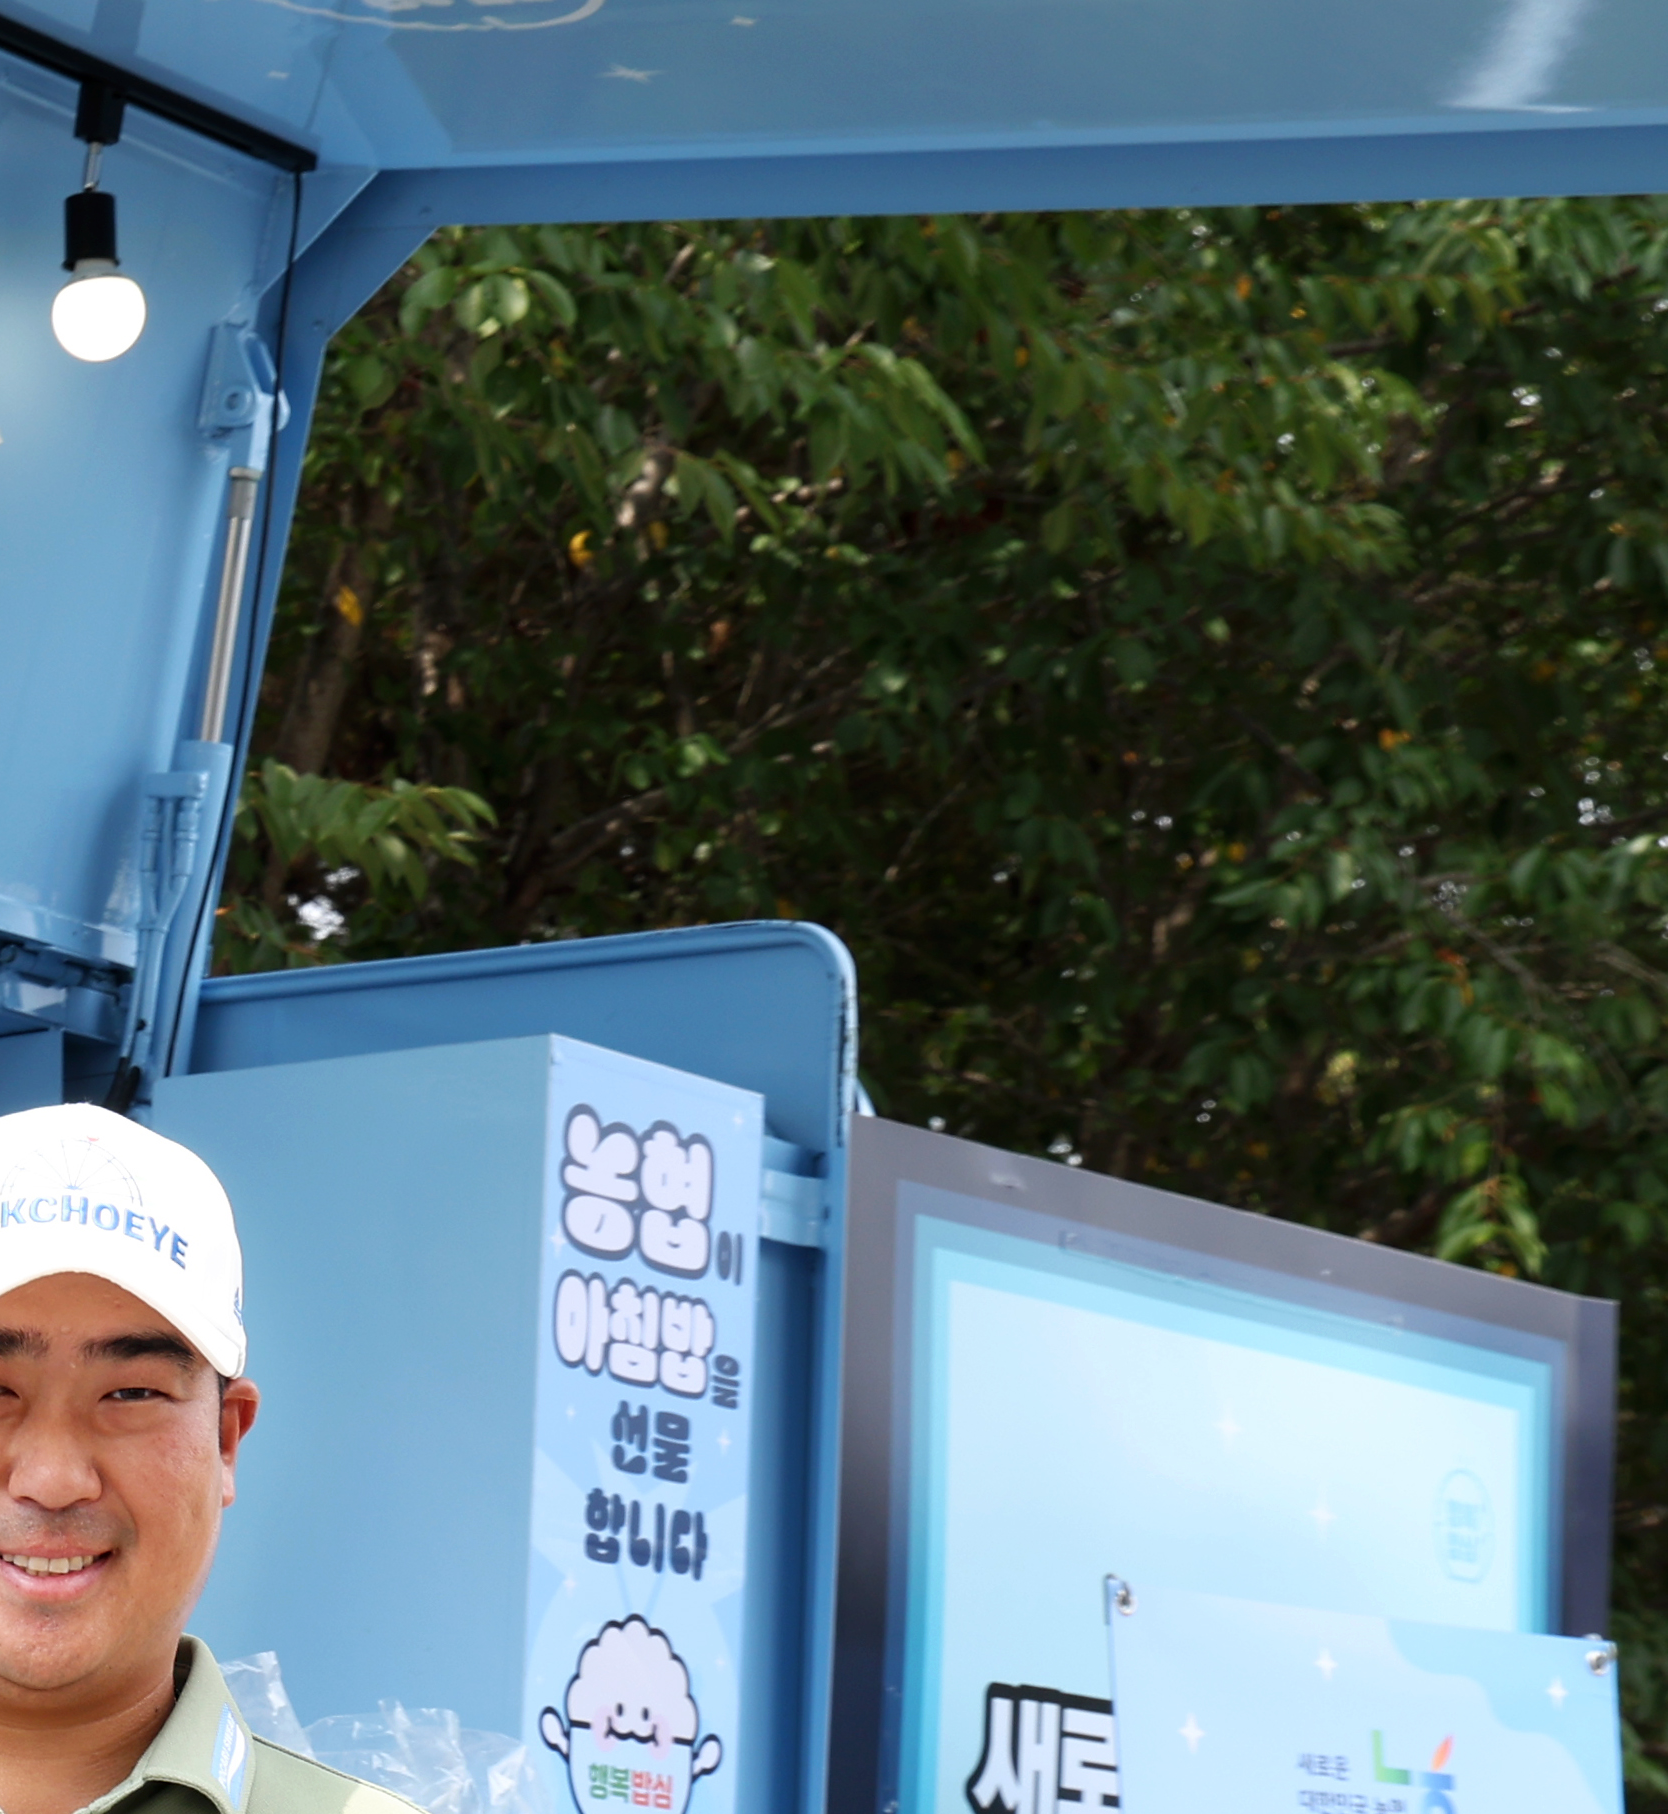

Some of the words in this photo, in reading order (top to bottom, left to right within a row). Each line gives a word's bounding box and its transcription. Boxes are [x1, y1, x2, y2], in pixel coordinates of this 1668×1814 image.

[612, 1401, 691, 1484] 선물
[584, 1487, 708, 1581] 합니다
[588, 1762, 674, 1811] 행복밥심
[1298, 1753, 1350, 1781] 새로운
